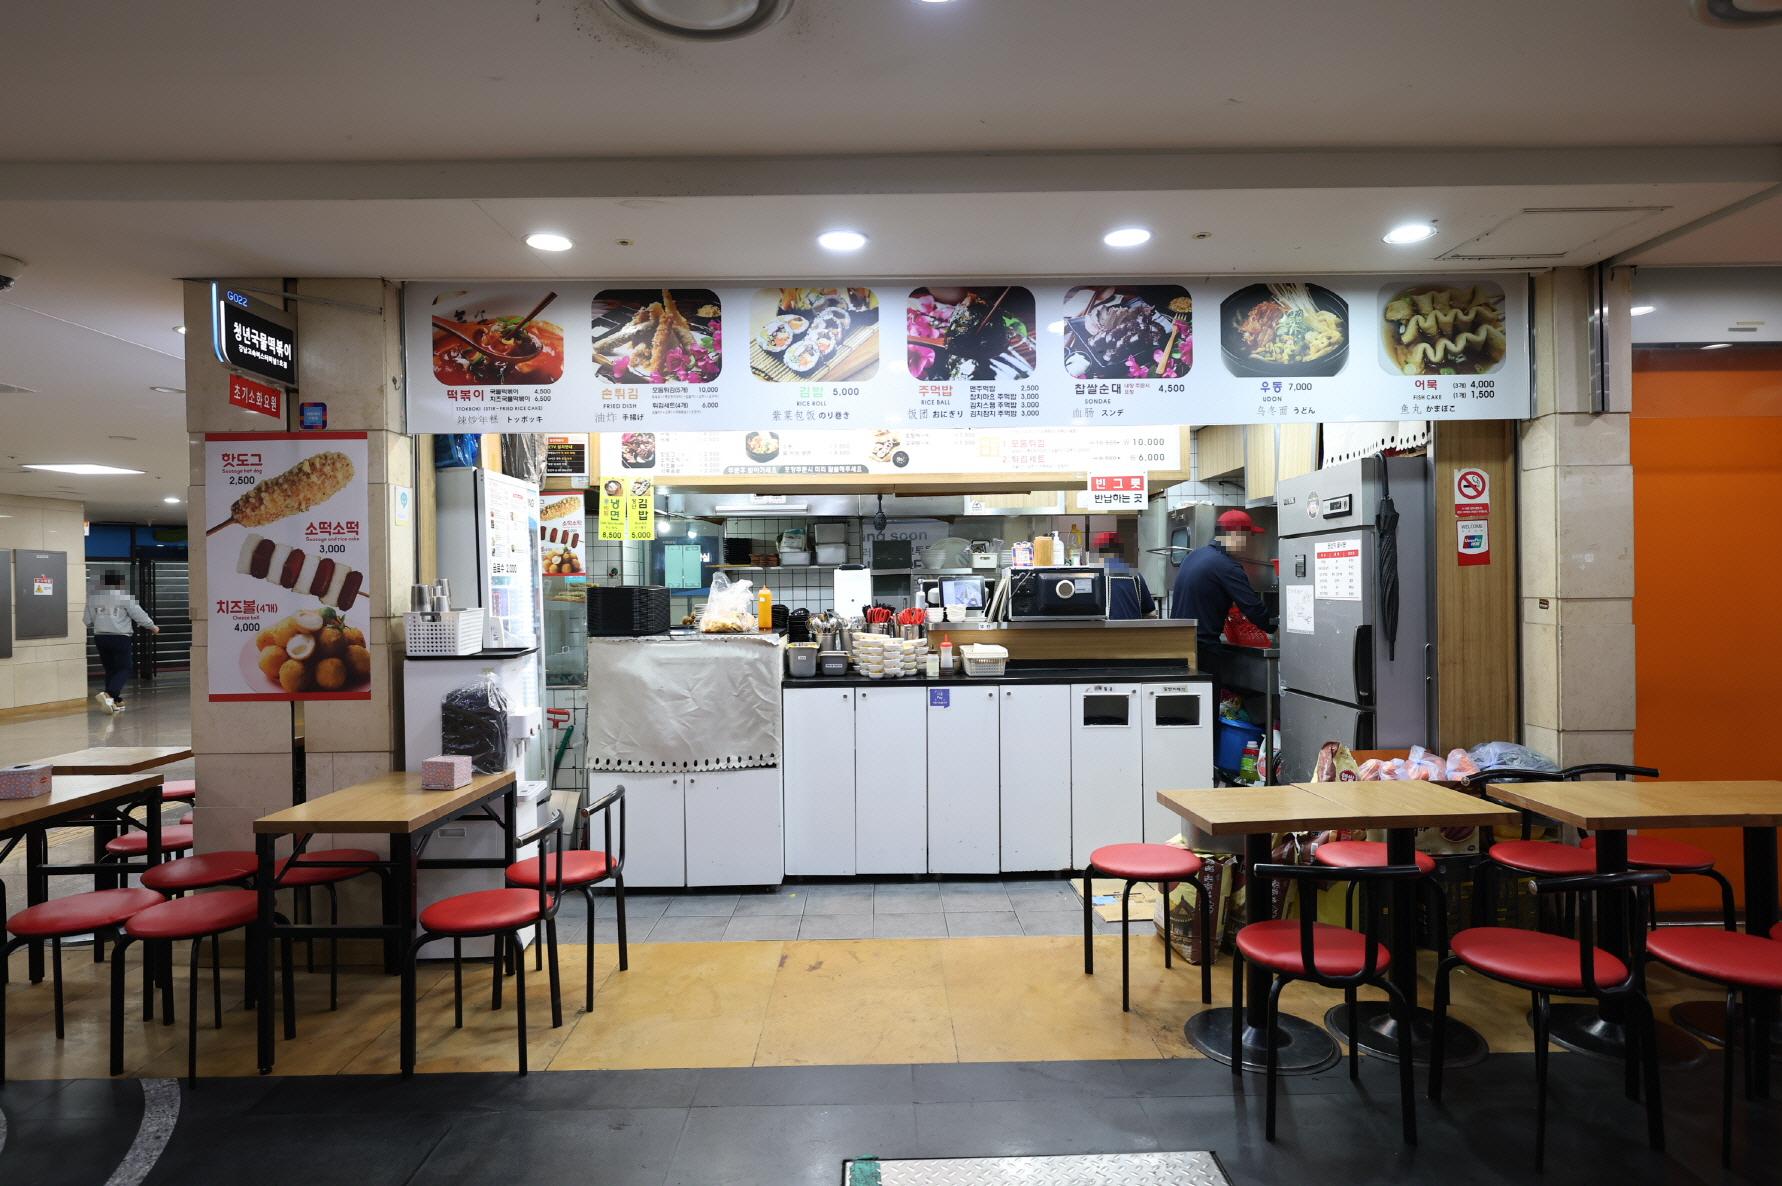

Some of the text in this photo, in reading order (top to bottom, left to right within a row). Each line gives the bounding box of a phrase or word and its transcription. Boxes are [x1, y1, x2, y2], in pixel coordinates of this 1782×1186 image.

[234, 322, 291, 361] 청년국물떡볶이
[1074, 383, 1122, 395] 찹쌀순대
[1158, 384, 1185, 393] 4,500
[1260, 382, 1283, 393] 우동
[1288, 383, 1313, 392] 7,000
[1414, 380, 1437, 390] 어묵
[1470, 380, 1494, 388] 4,000
[447, 390, 484, 402] 떡볶이
[602, 388, 639, 400] 손튀김
[800, 386, 824, 398] 김밥
[832, 388, 860, 396] 5,000
[919, 385, 954, 397] 주먹밥
[1471, 390, 1494, 398] 1,500
[234, 384, 277, 411] 초기소화요원
[932, 410, 964, 418] おにぎり
[1102, 408, 1124, 417] スンデ
[1294, 406, 1316, 415] うどん
[1132, 438, 1165, 446] 10,000
[222, 453, 263, 467] 핫도그
[1138, 454, 1165, 462] 6,000
[229, 476, 255, 486] 2,500
[1096, 478, 1106, 489] 빈
[1094, 494, 1143, 504] 반납하는 곳
[610, 498, 620, 521] 냉면
[638, 498, 648, 520] 김밥
[305, 521, 360, 536] 소떡소떡
[890, 531, 928, 540] soon
[320, 545, 346, 554] 3,000
[216, 600, 278, 614] 치즈볼(4개)
[234, 623, 260, 633] 4,000
